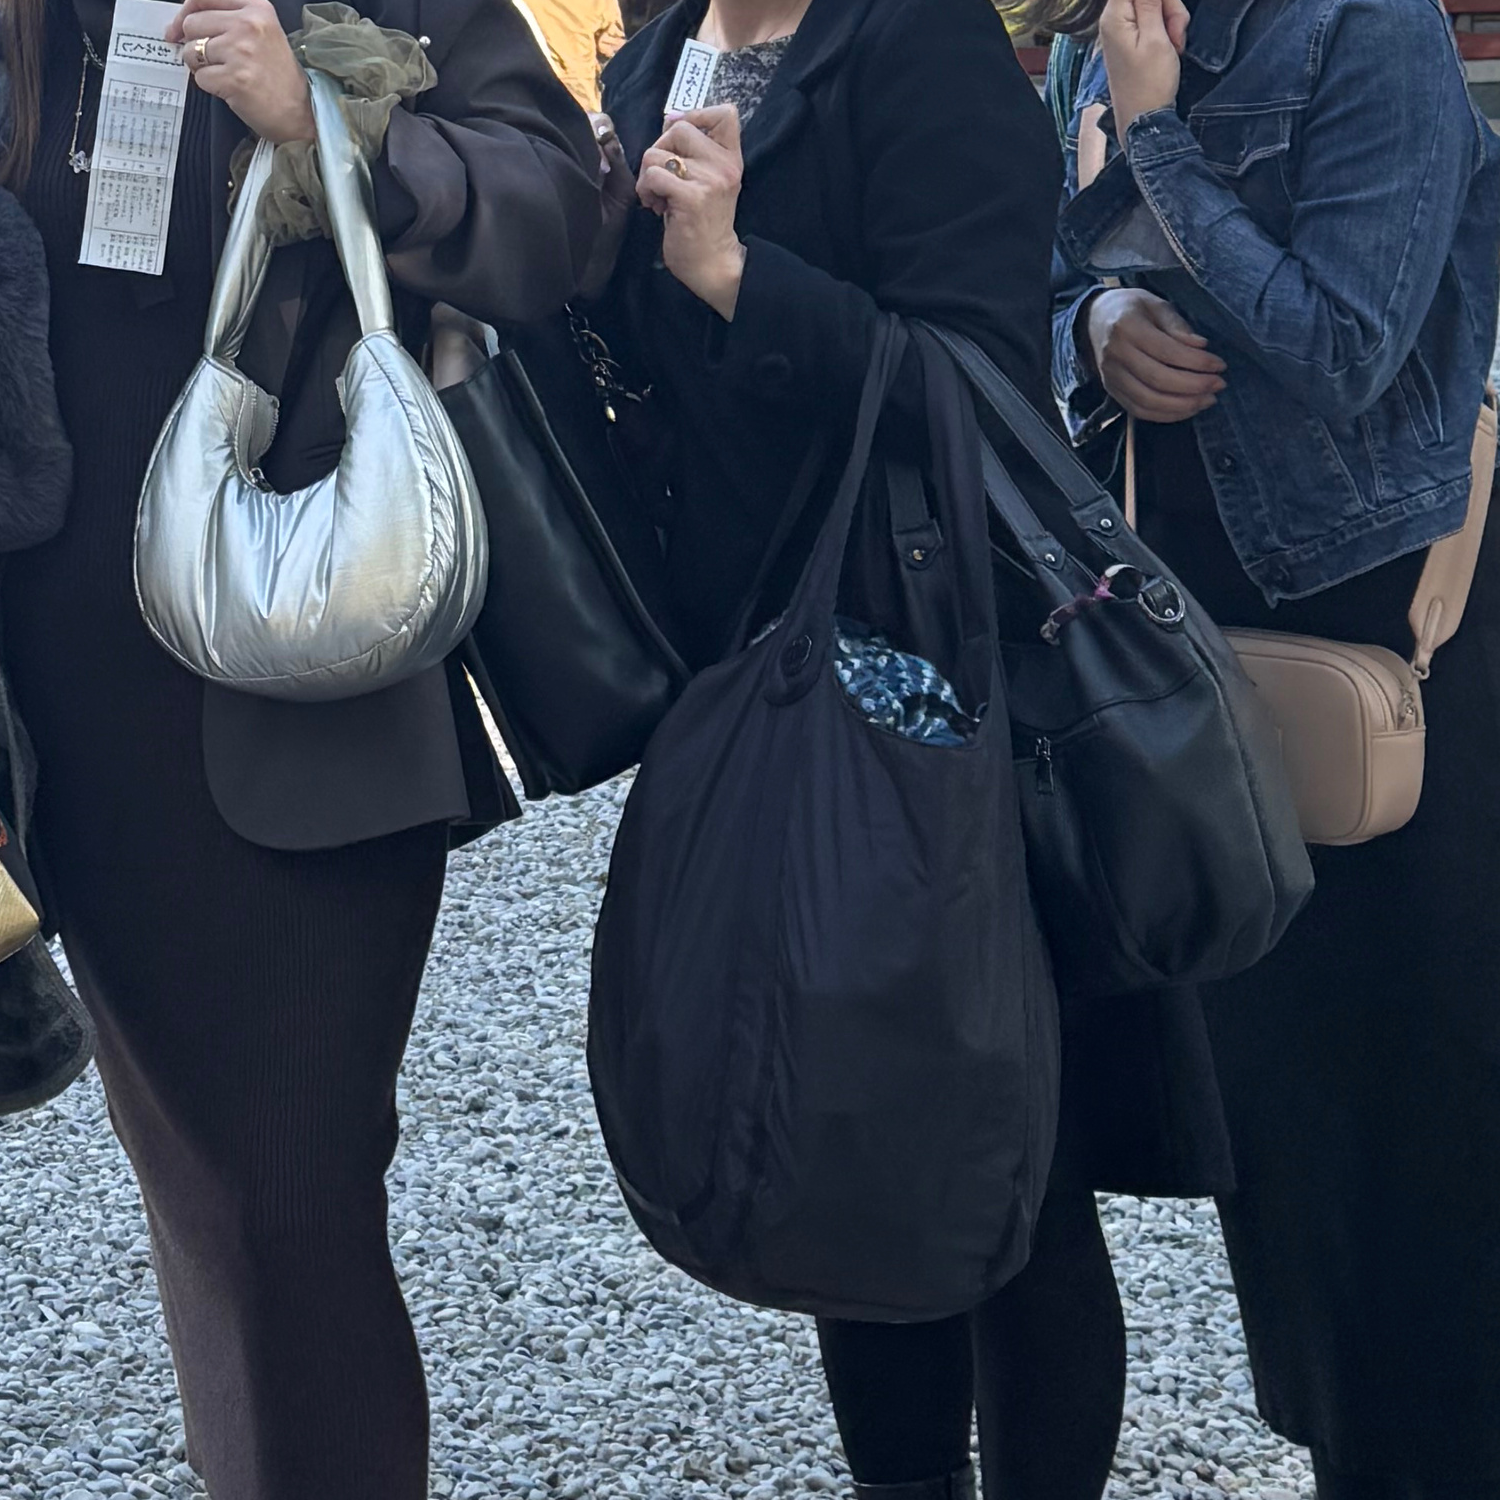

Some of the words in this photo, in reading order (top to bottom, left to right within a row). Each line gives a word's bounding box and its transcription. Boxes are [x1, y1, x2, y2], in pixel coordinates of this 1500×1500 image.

[122, 42, 172, 56] おみくじ
[682, 62, 701, 107] おみくじ
